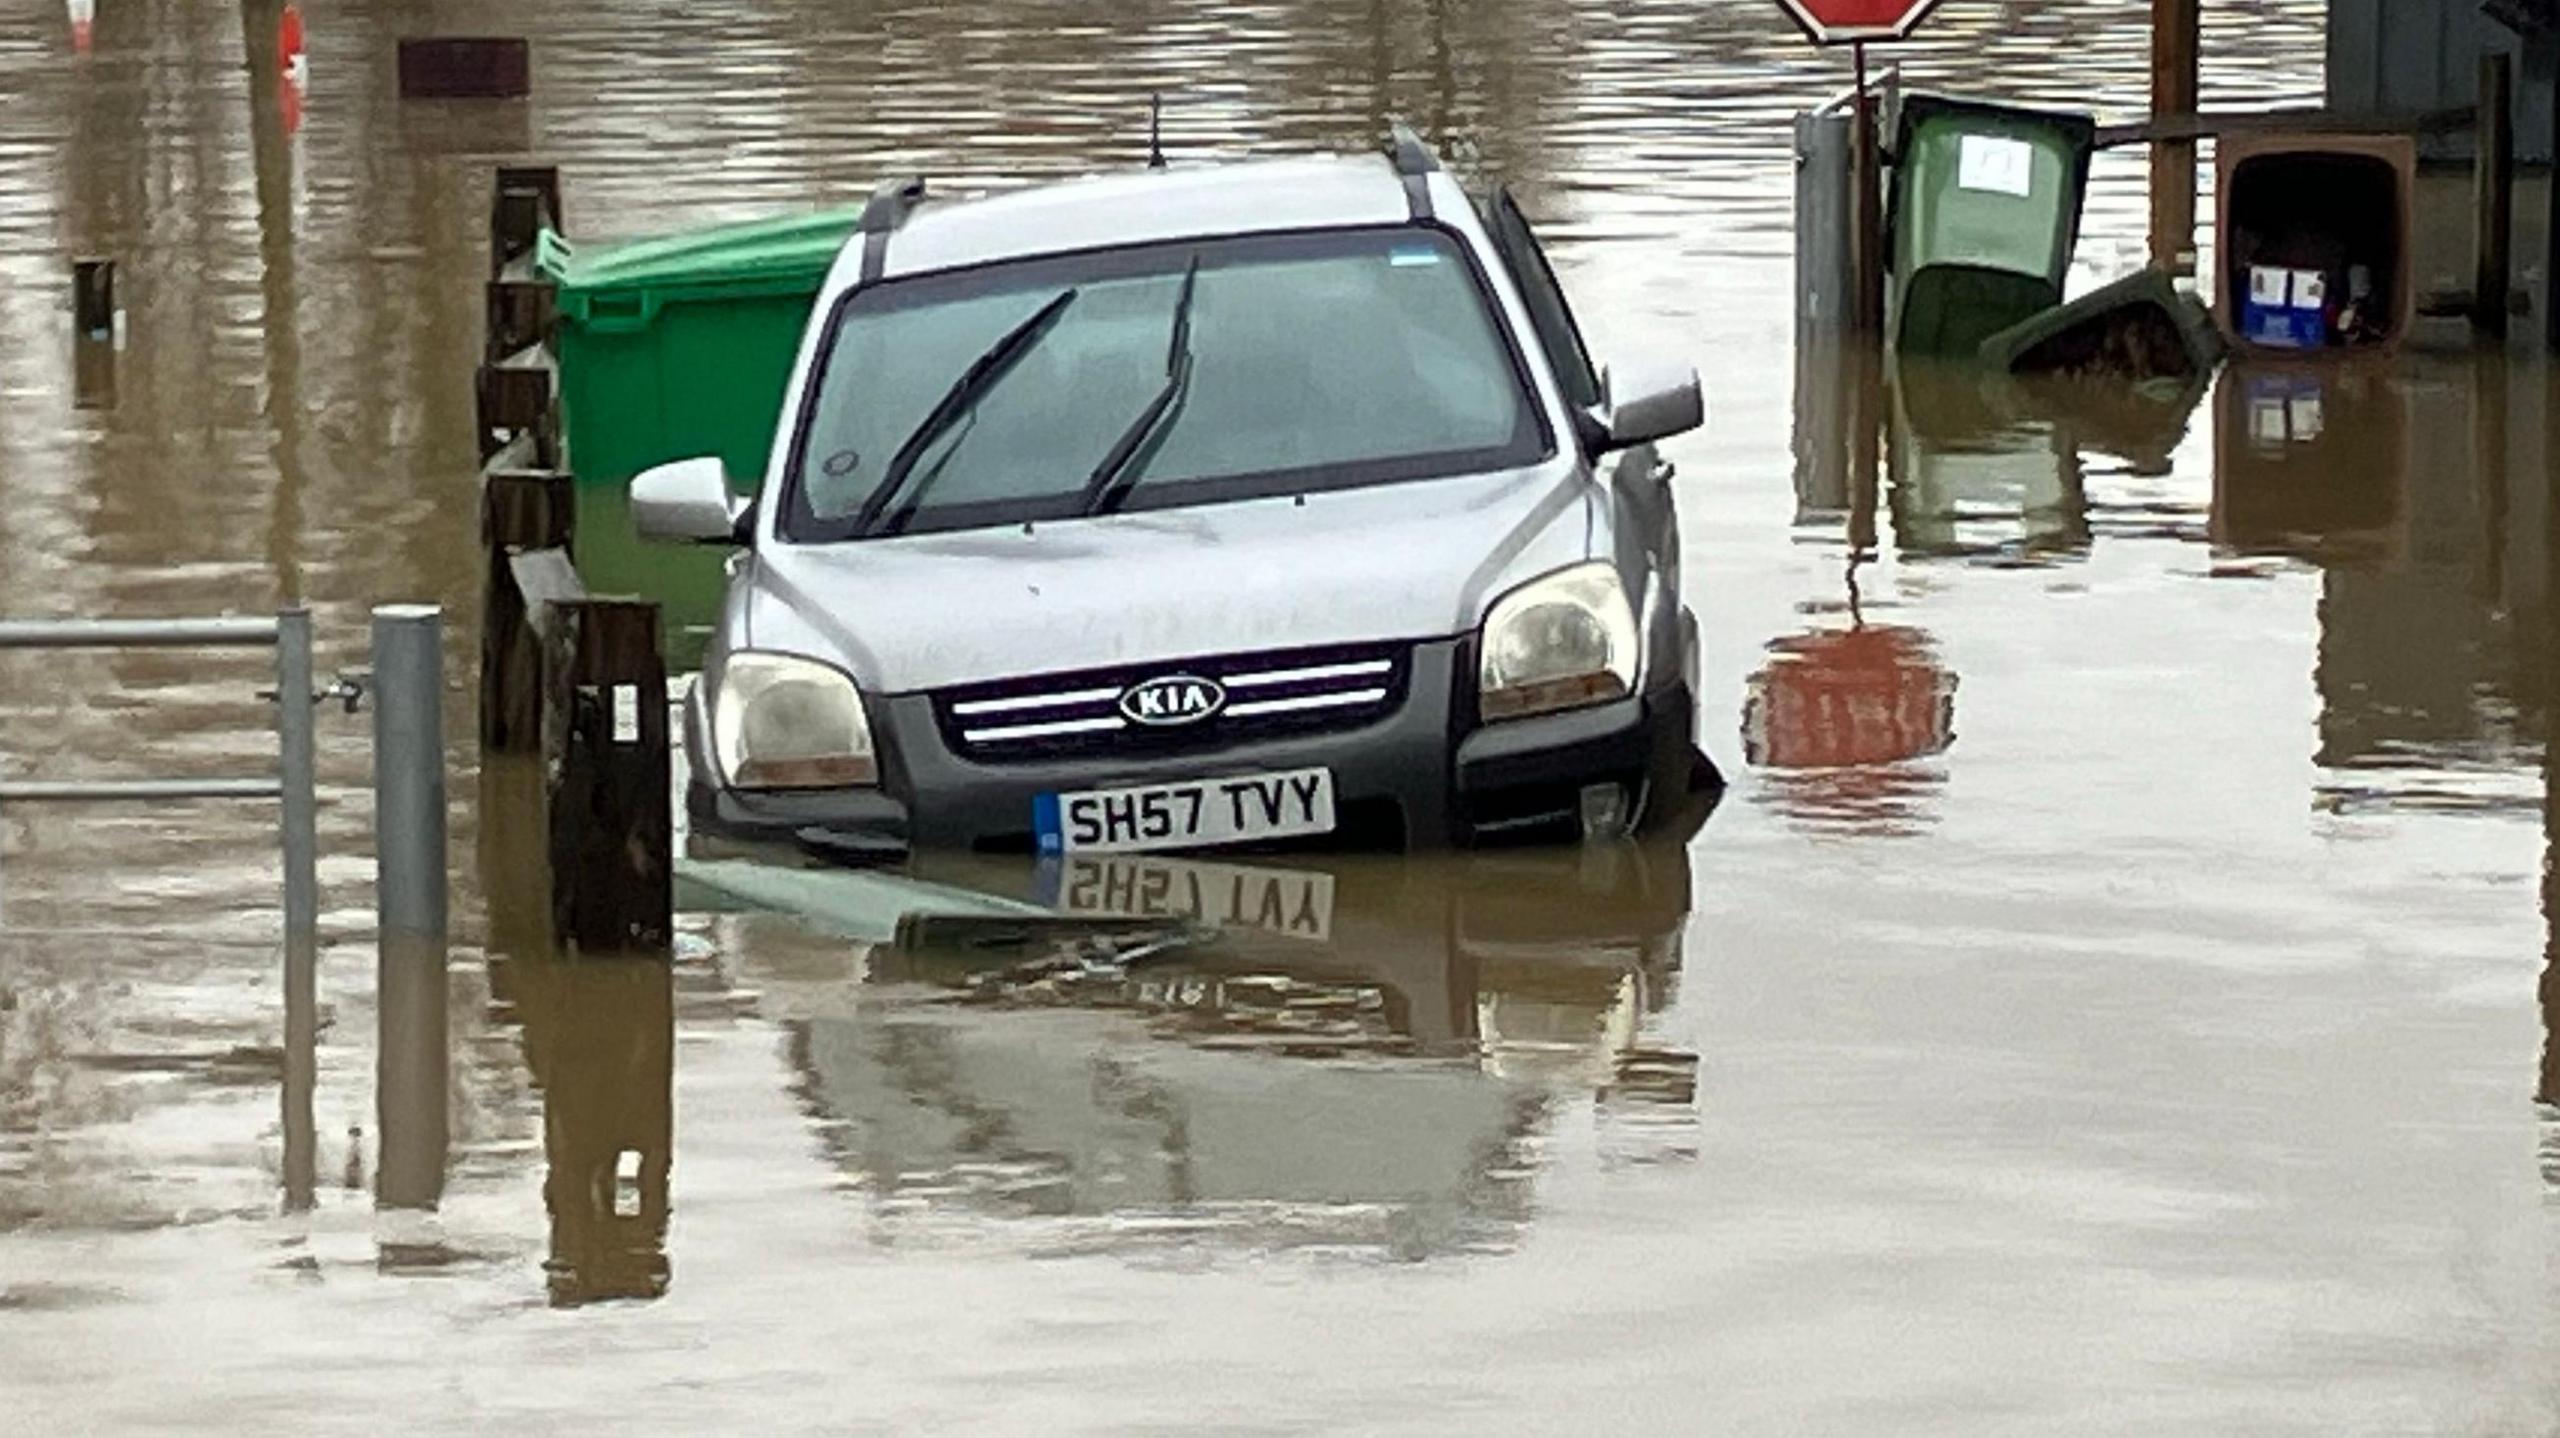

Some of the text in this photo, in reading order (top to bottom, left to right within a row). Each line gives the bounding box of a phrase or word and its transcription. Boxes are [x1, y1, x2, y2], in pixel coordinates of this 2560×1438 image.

[1139, 685, 1209, 714] KIA
[1070, 775, 1320, 844] SH57 TVY
